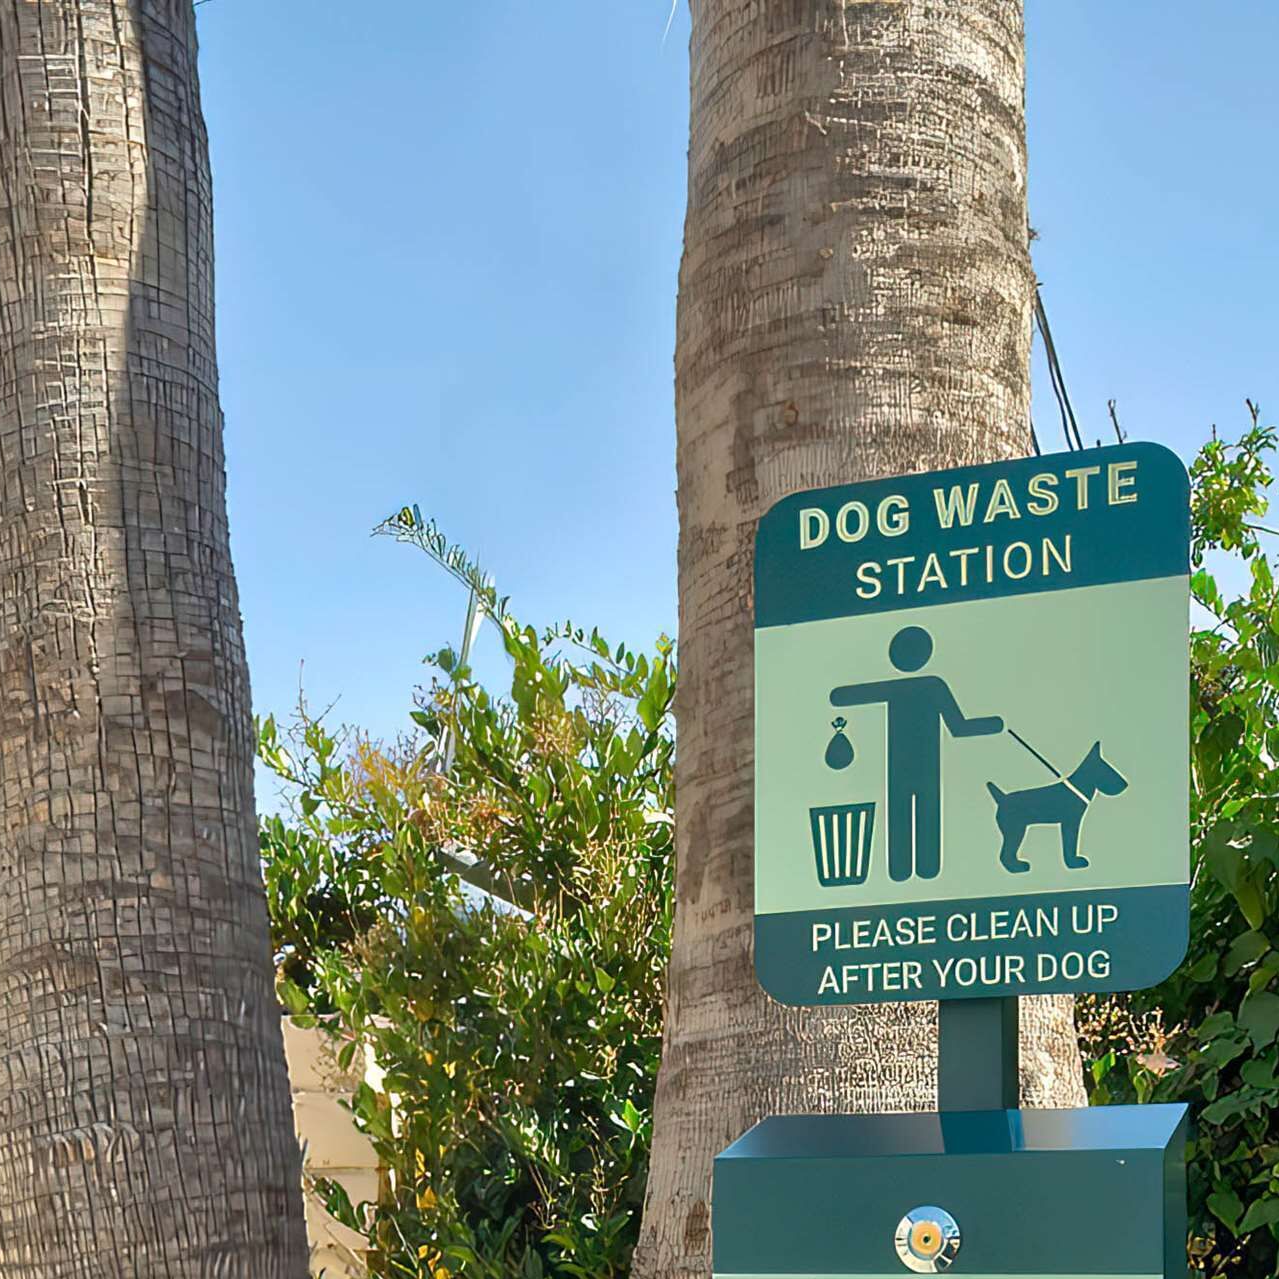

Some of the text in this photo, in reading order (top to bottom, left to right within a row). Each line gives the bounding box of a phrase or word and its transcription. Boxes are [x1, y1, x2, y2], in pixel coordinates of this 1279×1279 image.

[799, 461, 1138, 550] DOG WASTE
[856, 535, 1072, 599] STATION
[812, 904, 1119, 951] PLEASE CLEAN UP
[817, 951, 1111, 994] AFTER YOUR DOG
